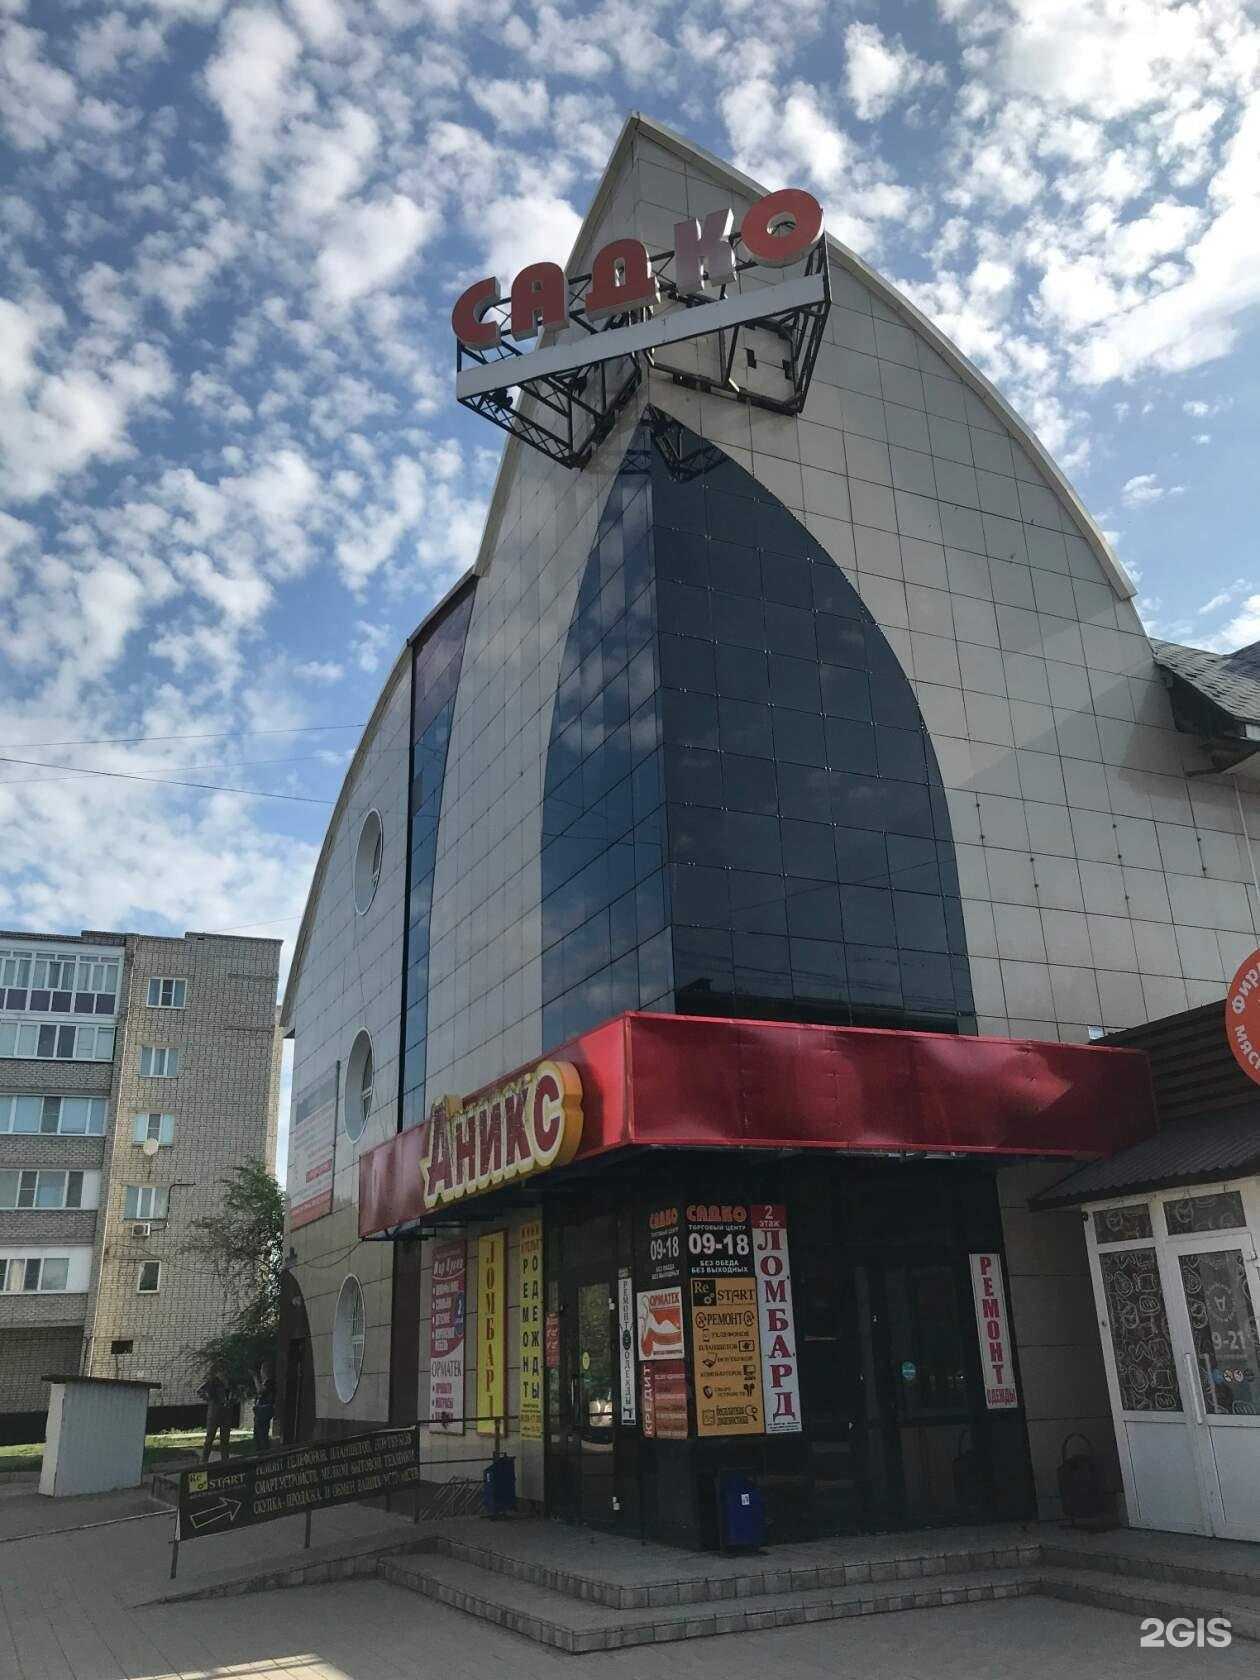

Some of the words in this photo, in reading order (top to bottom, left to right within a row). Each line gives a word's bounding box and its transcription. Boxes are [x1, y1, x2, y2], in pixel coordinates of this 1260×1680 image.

[452, 188, 824, 350] САДКО
[424, 1072, 564, 1200] АНИКС
[686, 1205, 747, 1222] САДКО
[763, 1205, 774, 1220] 2
[725, 1224, 746, 1232] ЦЕНТР
[760, 1220, 780, 1228] этаж
[650, 1235, 680, 1260] 09-18
[688, 1232, 750, 1255] 09-18
[691, 1266, 706, 1274] БЕЗ
[706, 1266, 749, 1274] ВЫХОДНЫХ
[694, 1281, 710, 1294] Re
[717, 1288, 755, 1303] START
[532, 1254, 540, 1400] ОДЕЖДЫ
[706, 1311, 744, 1326] РЕМОНТ
[757, 1229, 797, 1423] ЛОМБАРД
[979, 1256, 1004, 1385] РЕМОНТ
[432, 1359, 462, 1377] ОРМАТЕК
[643, 1364, 653, 1435] КРЕДИТ
[208, 1472, 247, 1489] START
